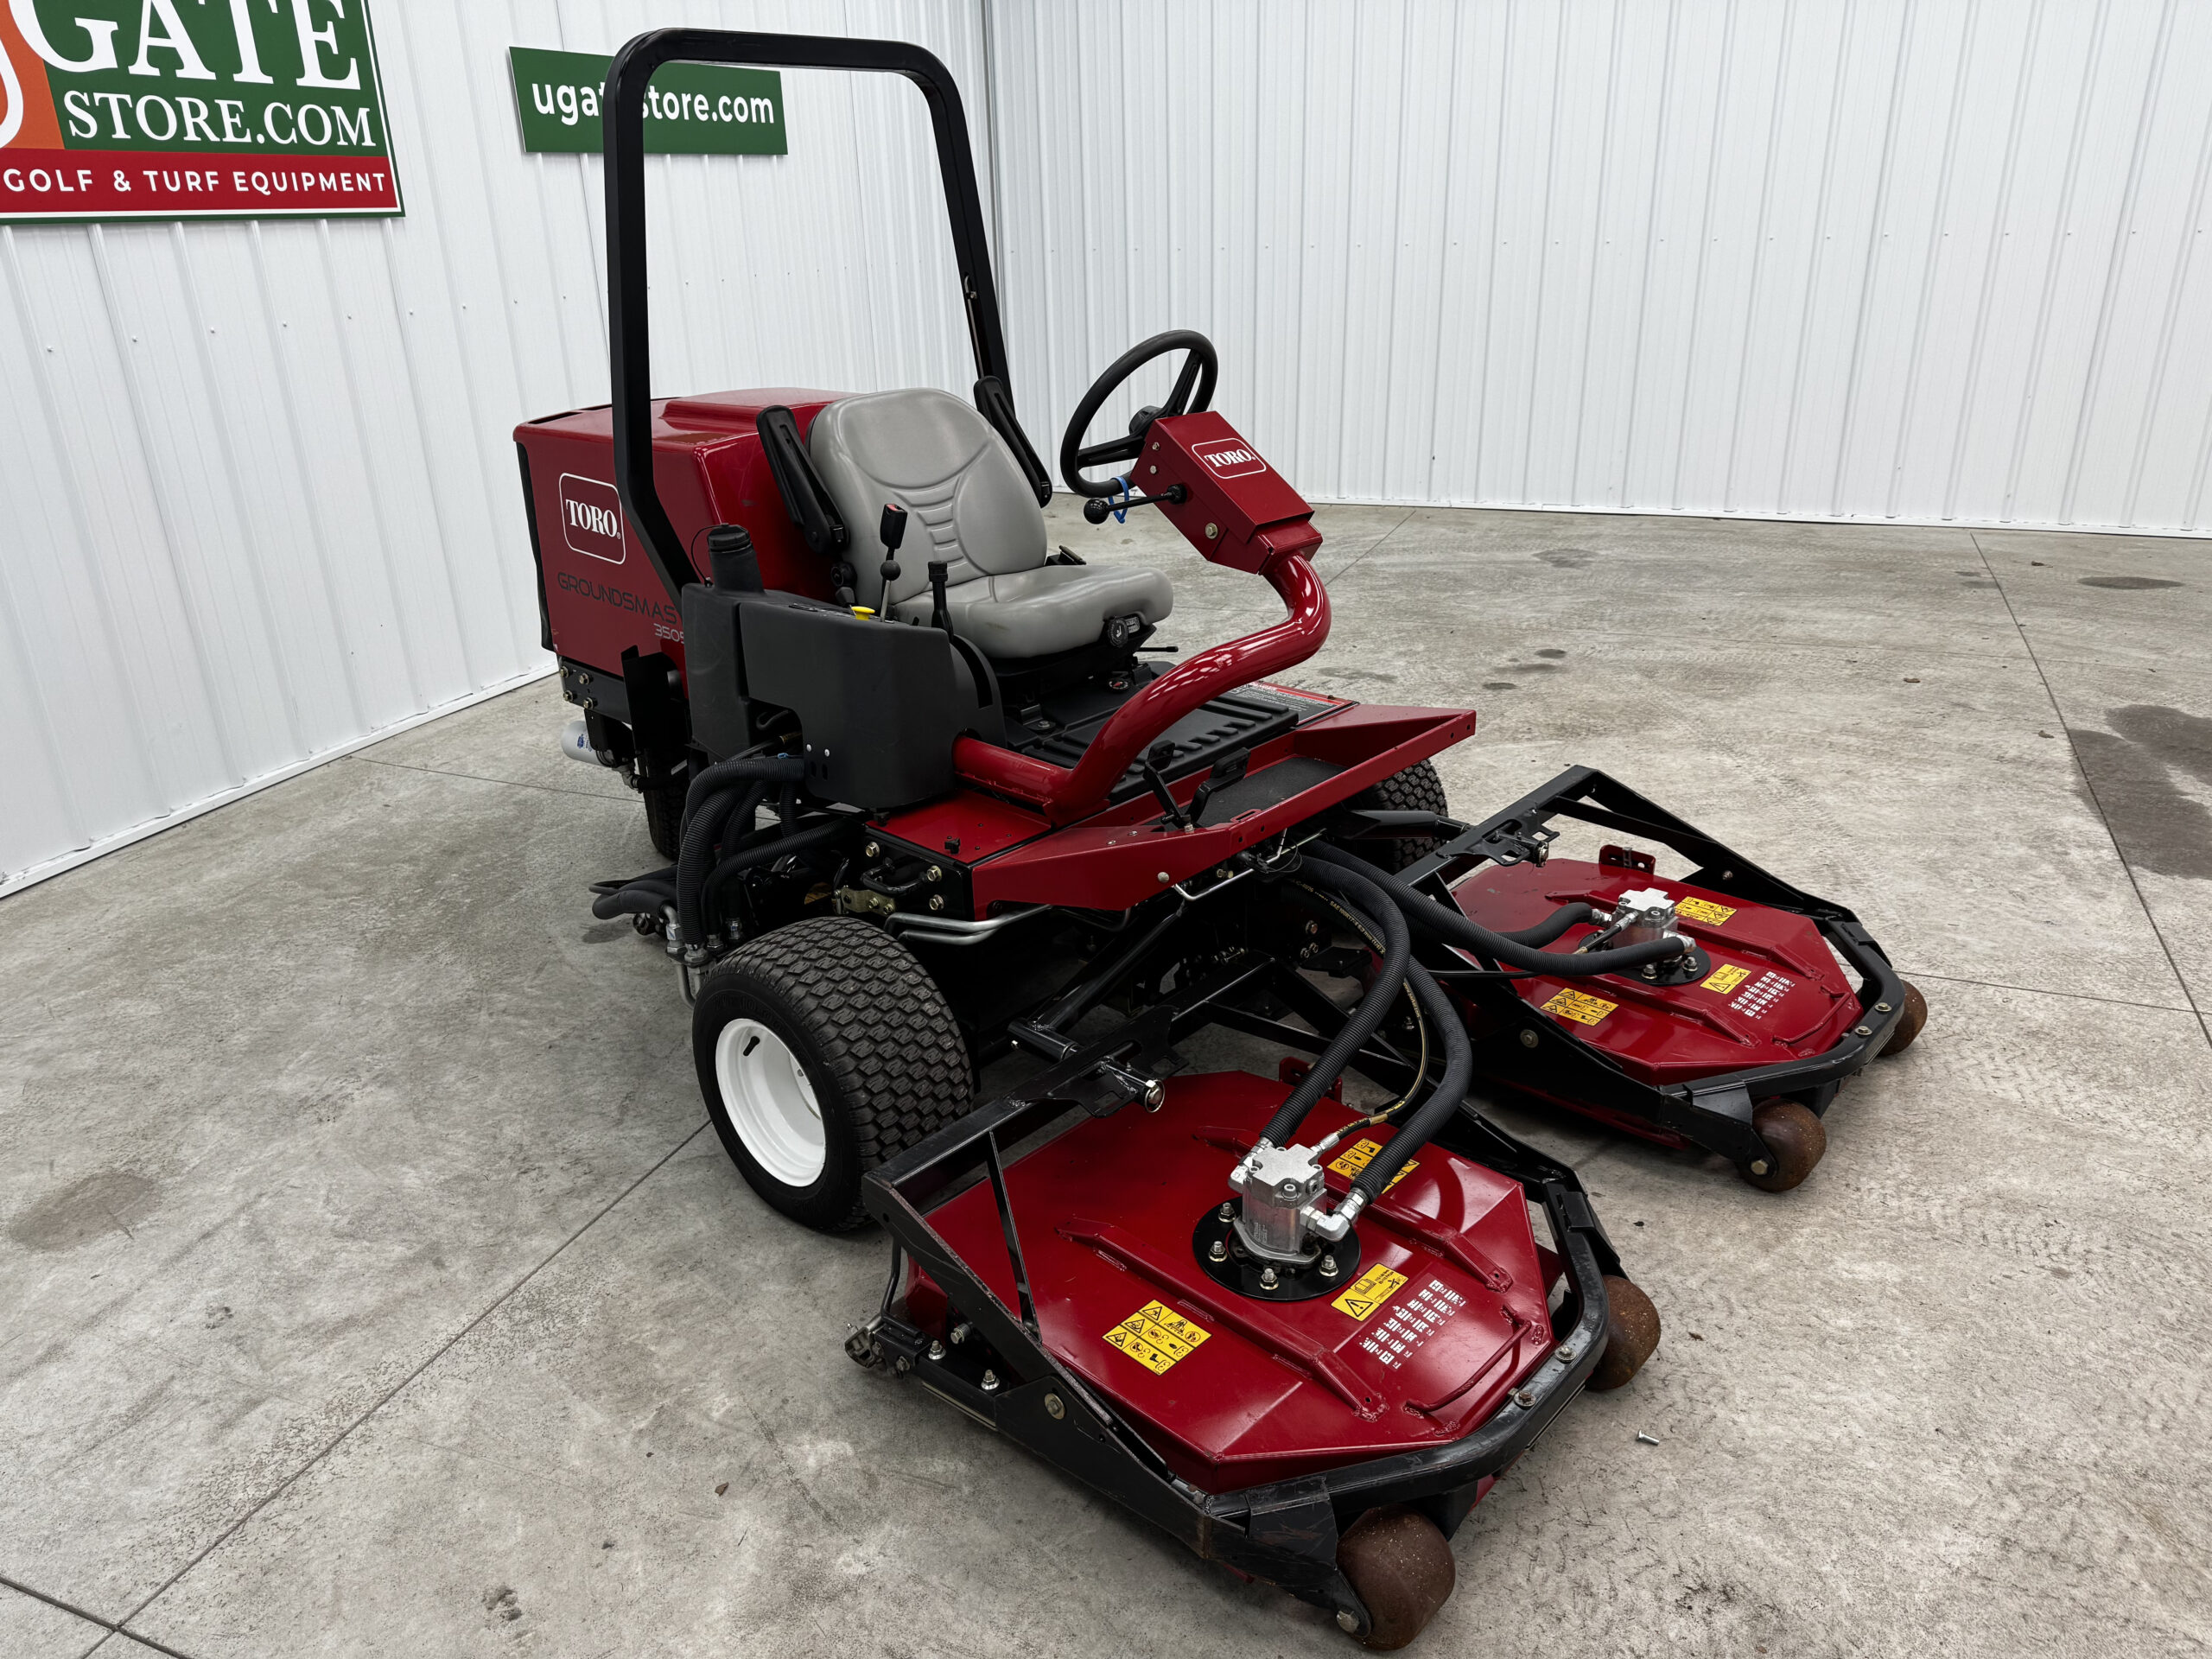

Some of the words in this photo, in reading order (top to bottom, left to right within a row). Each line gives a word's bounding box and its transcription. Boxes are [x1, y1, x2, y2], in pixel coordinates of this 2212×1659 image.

[64, 90, 377, 147] STORE.COM
[532, 81, 775, 126] ugatore.com
[3, 168, 93, 192] GOLF
[113, 169, 131, 192] &
[143, 170, 219, 192] TURF
[232, 171, 385, 195] EQUIPMENT
[1204, 448, 1252, 467] TORO
[565, 499, 618, 537] TORO
